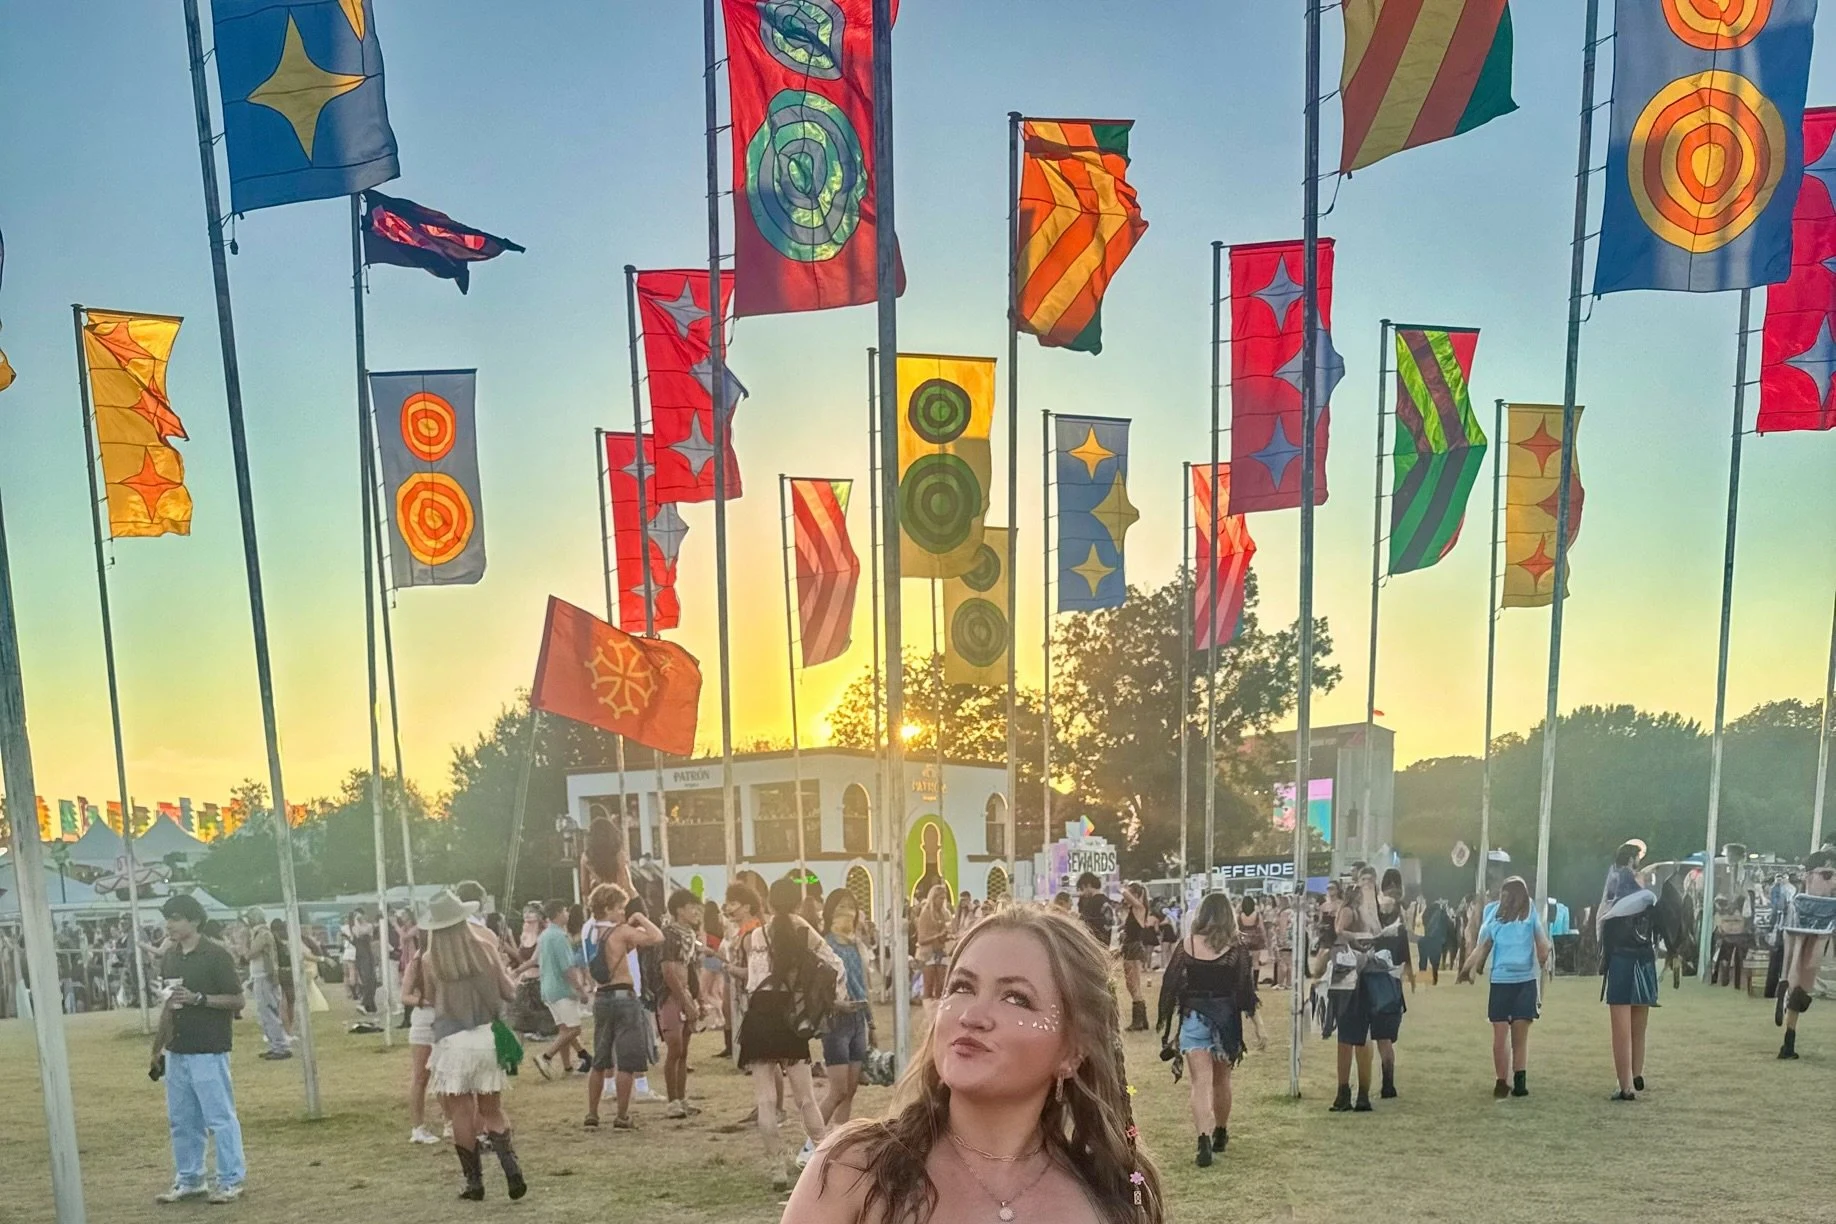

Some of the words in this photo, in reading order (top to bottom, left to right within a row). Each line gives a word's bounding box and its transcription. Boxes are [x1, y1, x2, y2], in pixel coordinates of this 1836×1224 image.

[673, 767, 710, 782] PATRÓN
[912, 779, 948, 793] PATR
[1068, 852, 1115, 872] REWARDS
[1211, 862, 1296, 878] DEFENDE
